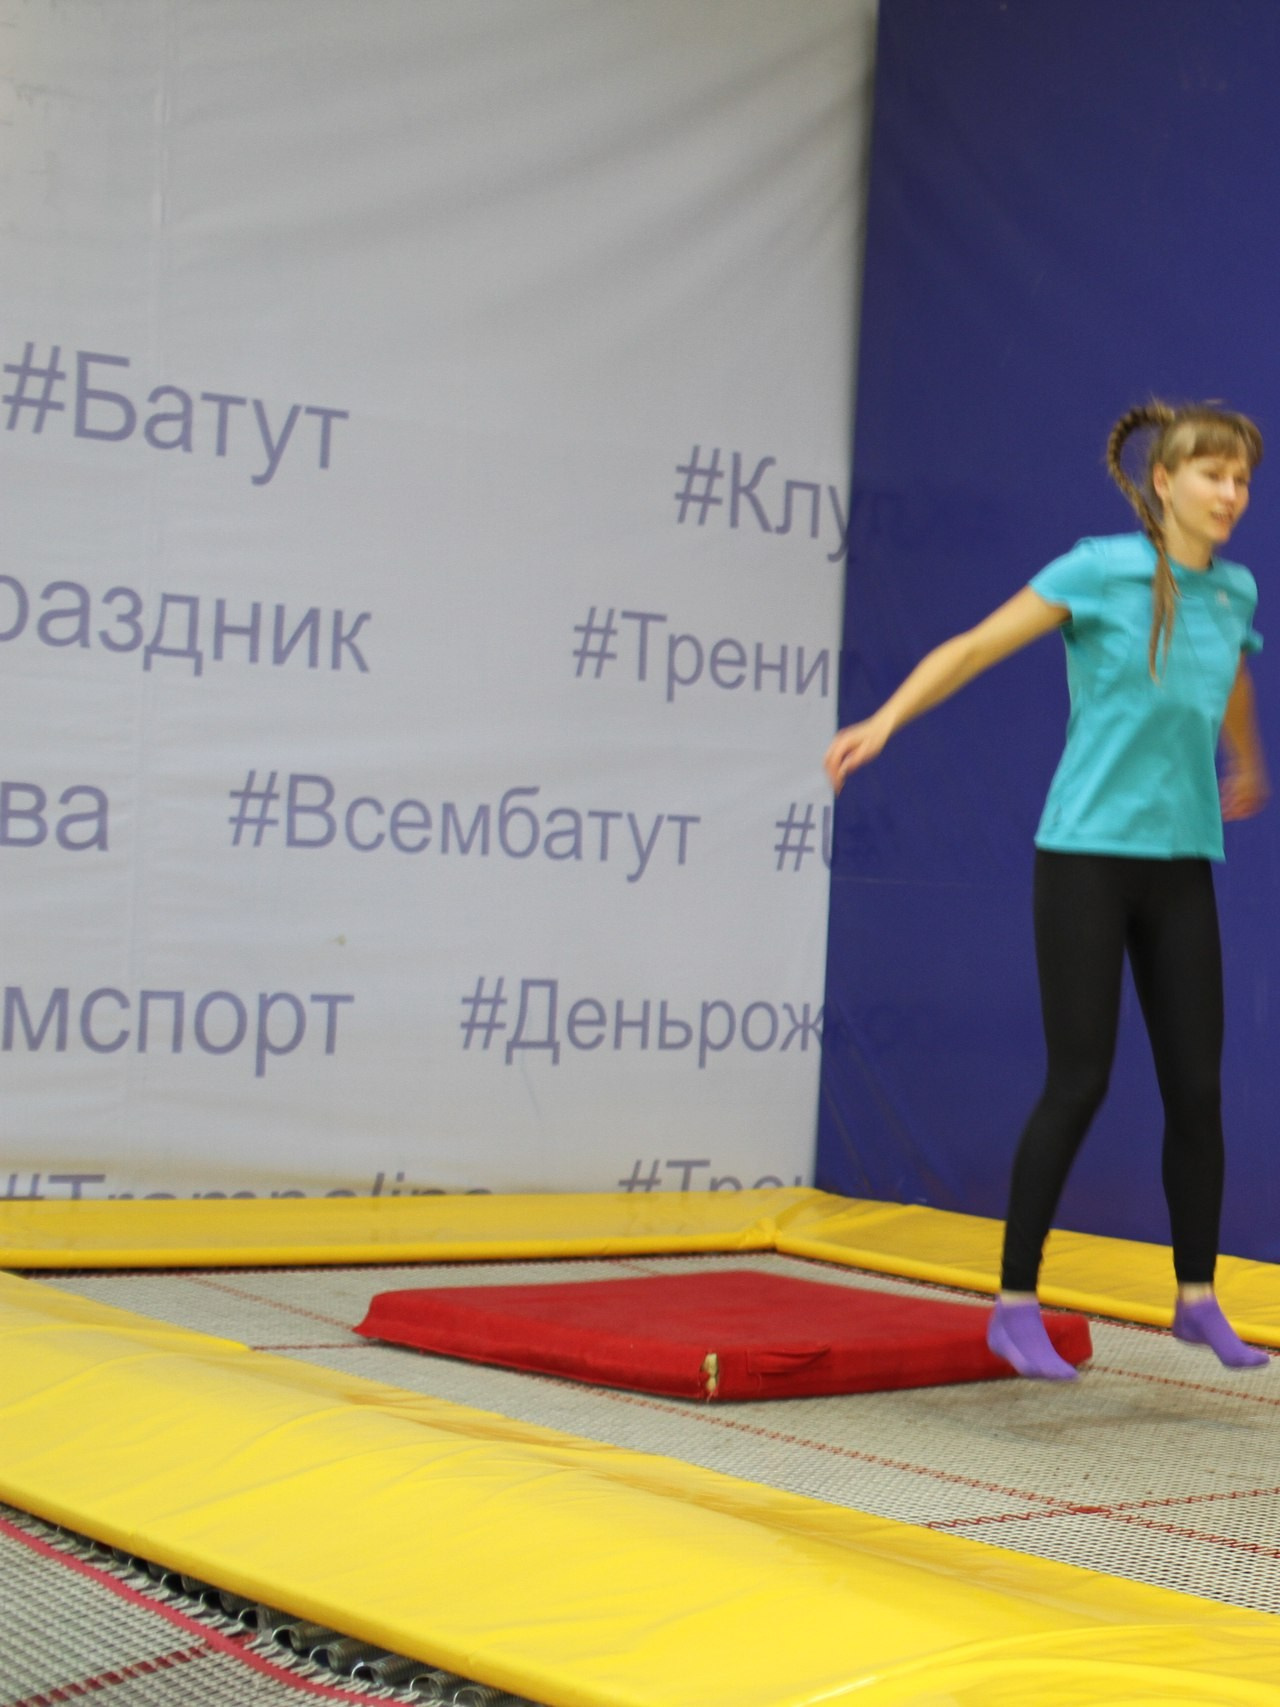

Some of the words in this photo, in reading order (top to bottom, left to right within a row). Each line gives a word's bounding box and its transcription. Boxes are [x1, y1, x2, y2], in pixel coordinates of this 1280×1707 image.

[2, 341, 350, 485] #Батут
[573, 606, 830, 702] #Трени
[0, 781, 109, 852] ва
[228, 769, 701, 884] #Всембатут
[2, 984, 354, 1077] мспорт
[459, 976, 823, 1068] #Деньрож
